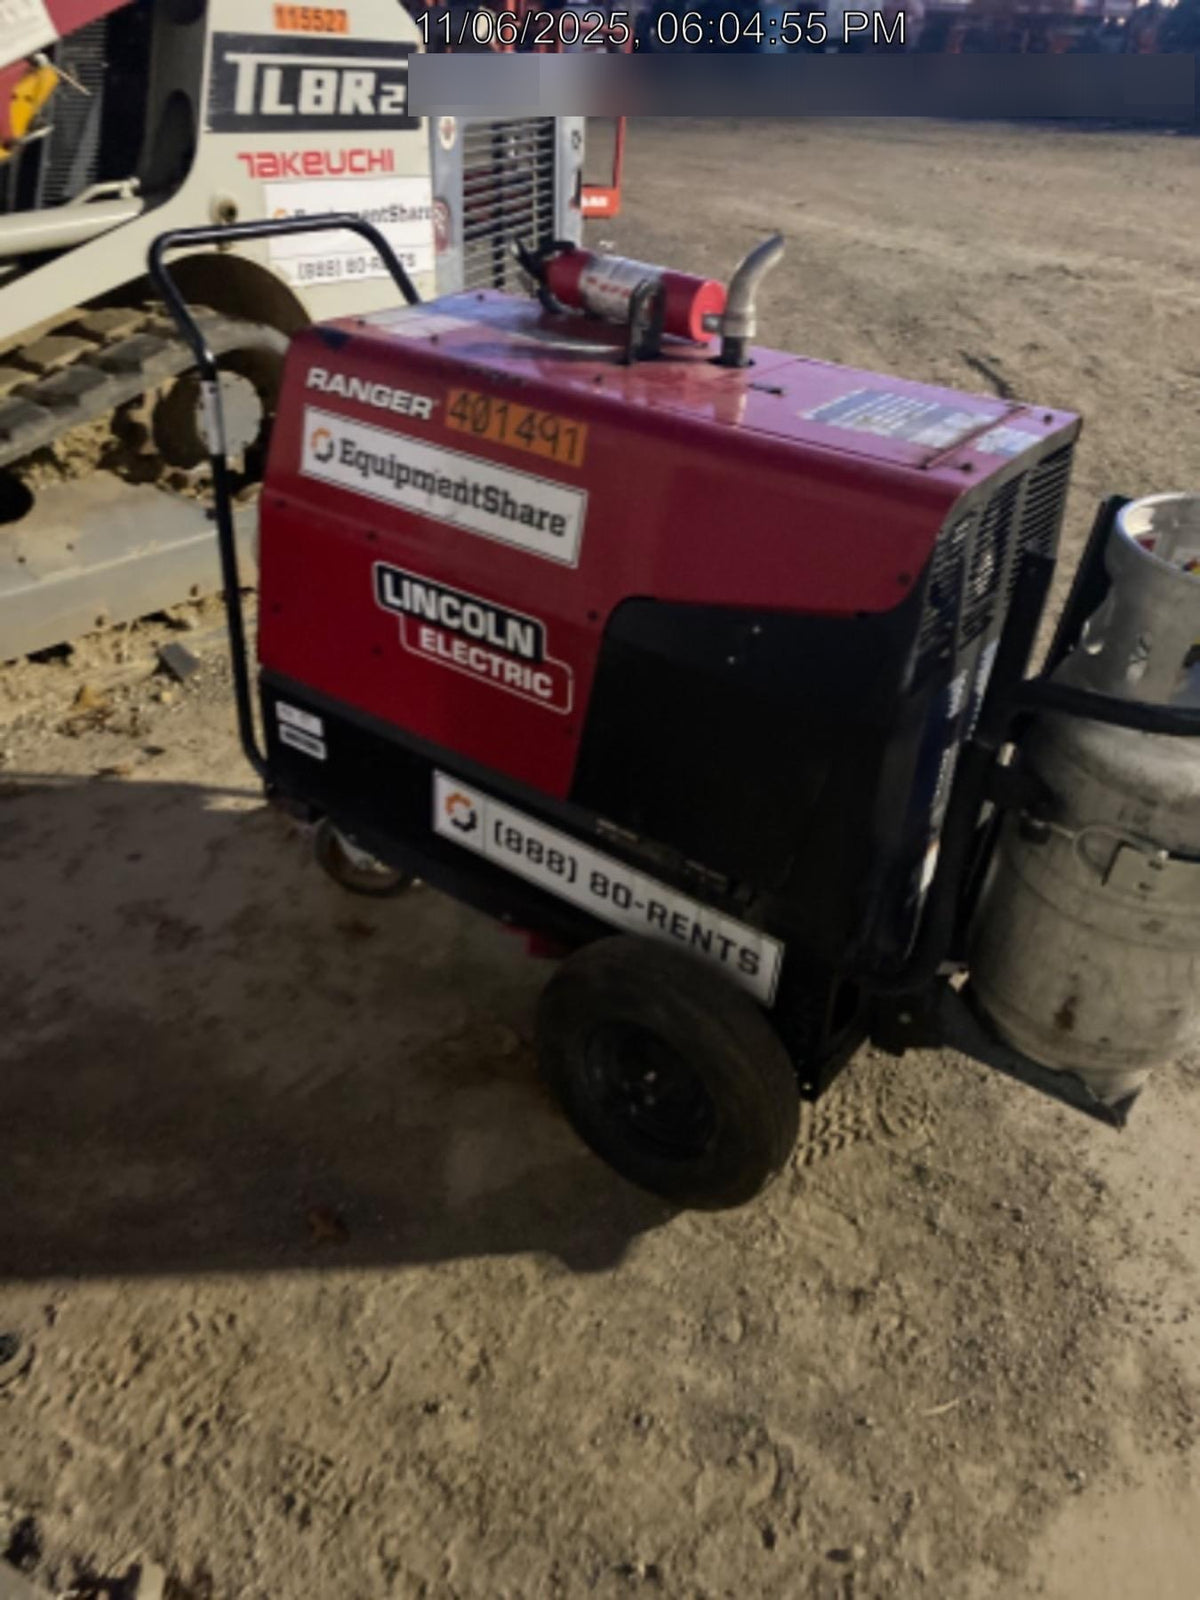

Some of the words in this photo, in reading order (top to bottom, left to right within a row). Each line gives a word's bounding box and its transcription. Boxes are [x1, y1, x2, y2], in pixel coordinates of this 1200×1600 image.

[306, 367, 432, 420] RANGER
[449, 393, 579, 461] 401491
[338, 437, 567, 537] EquipmentShare
[382, 572, 535, 657] LINCOLN
[418, 626, 553, 698] ELECTRIC
[493, 820, 578, 884] (888)
[589, 870, 761, 977] 80-RENTS
